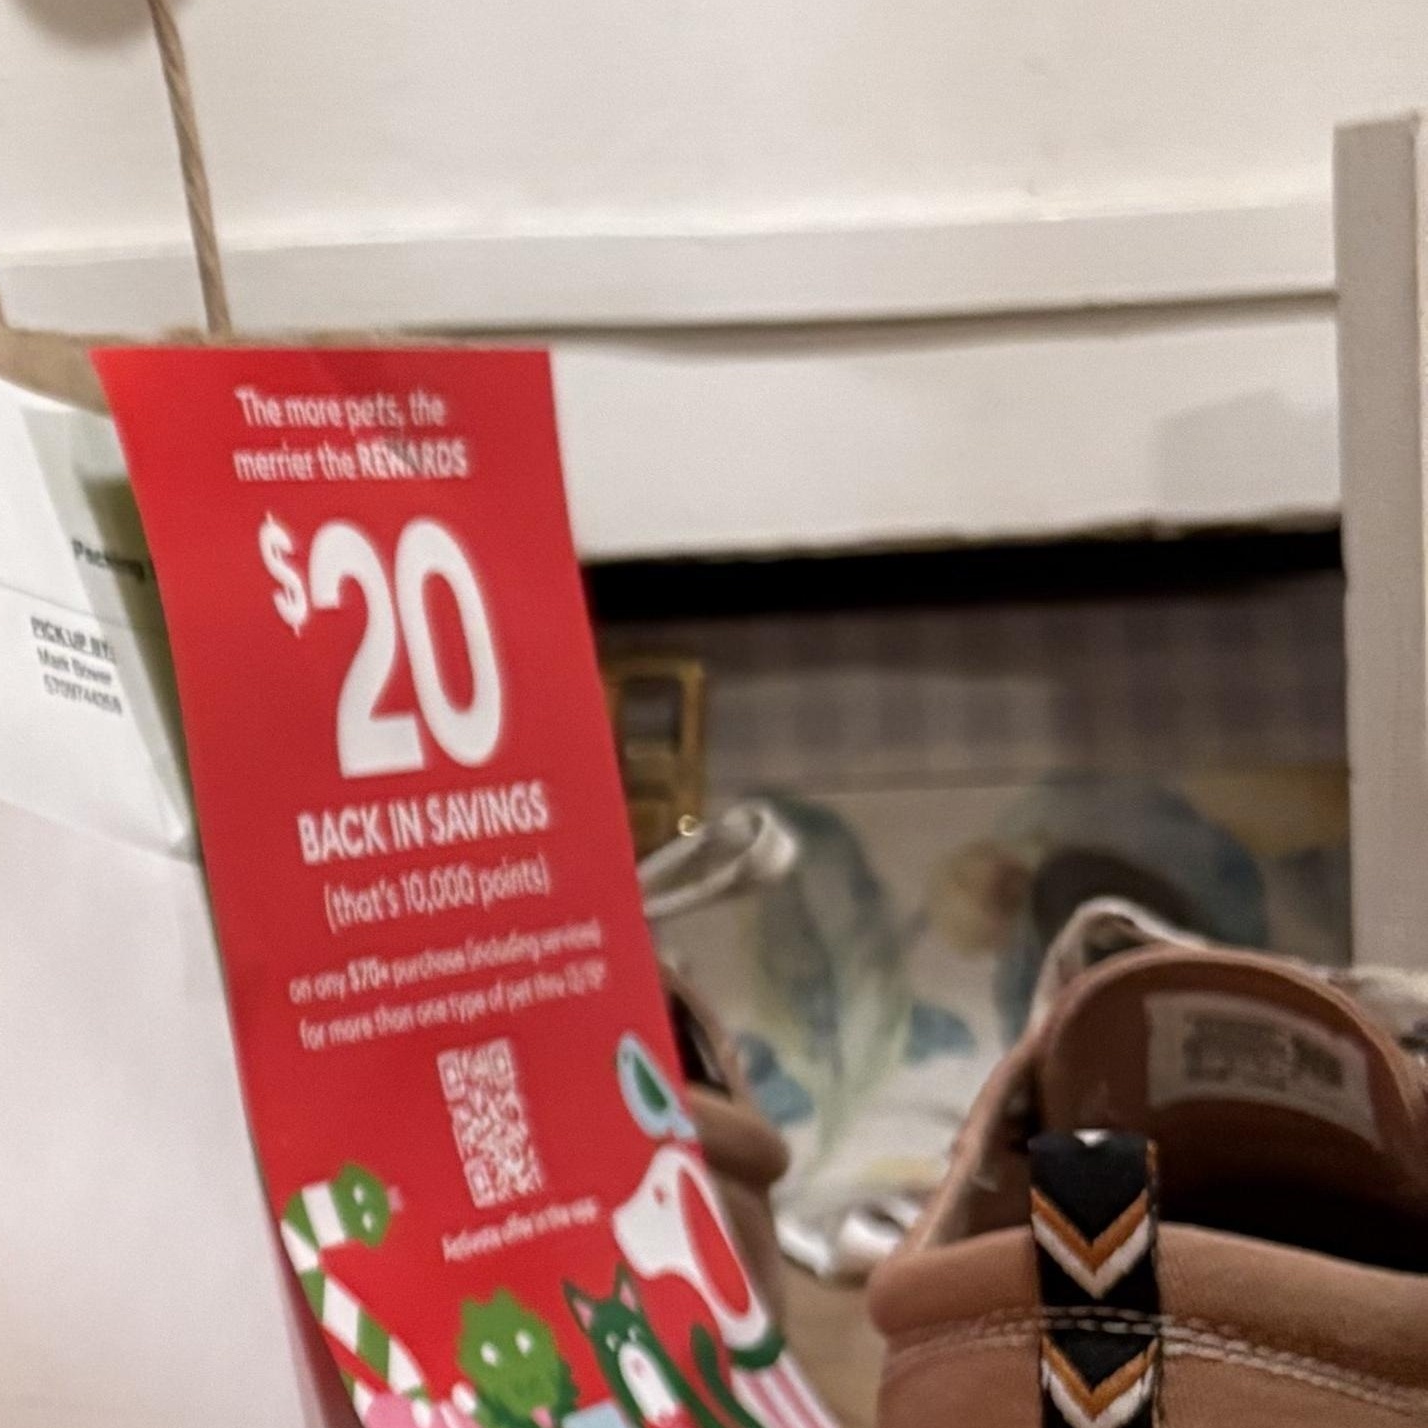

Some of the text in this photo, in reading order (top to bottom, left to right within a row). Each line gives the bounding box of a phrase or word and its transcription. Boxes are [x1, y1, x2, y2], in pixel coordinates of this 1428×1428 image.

[235, 385, 281, 428] The
[285, 396, 343, 428] more
[408, 387, 446, 427] the
[233, 437, 468, 481] merrier the REWARDS
[257, 511, 502, 778] $20
[297, 779, 549, 864] BACK IN SAVINGS
[324, 850, 550, 934] (that's 10,000 points)
